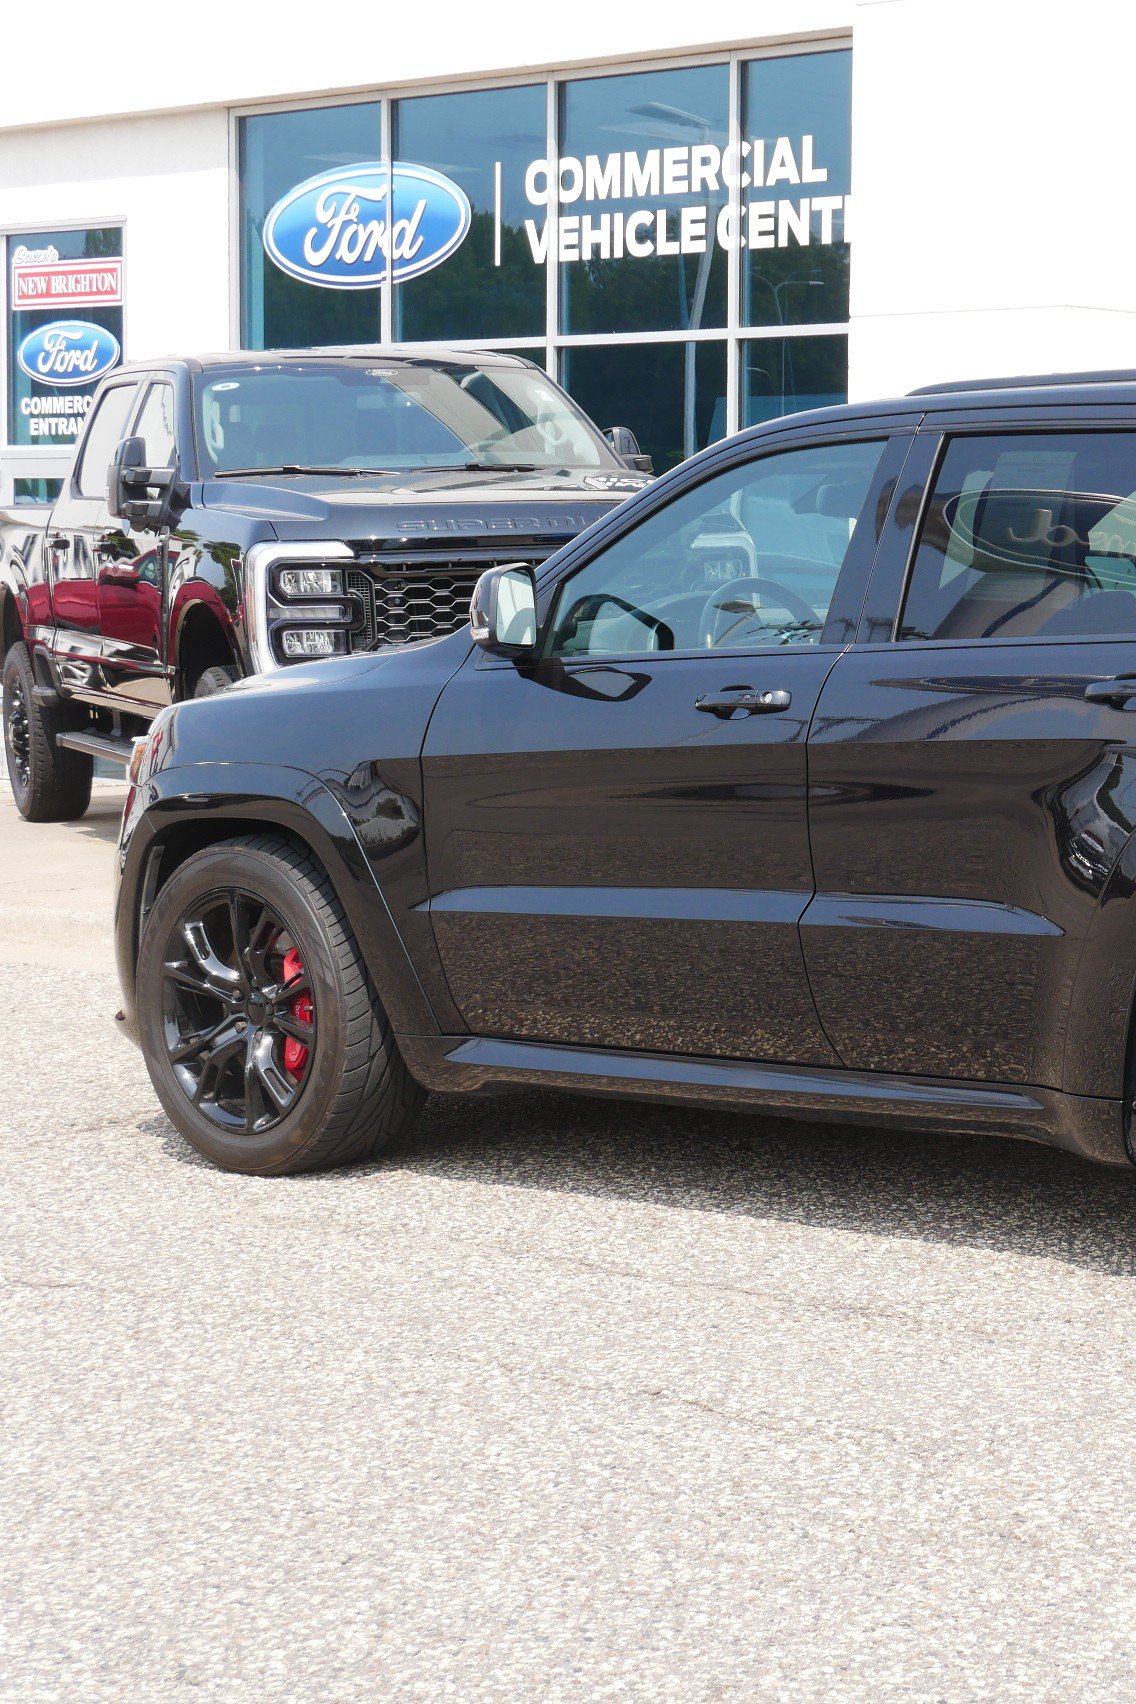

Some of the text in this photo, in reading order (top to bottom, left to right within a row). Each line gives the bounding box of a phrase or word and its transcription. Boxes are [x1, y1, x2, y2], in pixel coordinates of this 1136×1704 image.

[525, 135, 828, 206] COMMERCIAL
[303, 183, 428, 267] Ford
[524, 206, 707, 264] VEHICLE
[18, 272, 118, 296] NEW BRIGHTON
[37, 329, 100, 373] Ford
[397, 517, 541, 532] SUPER
